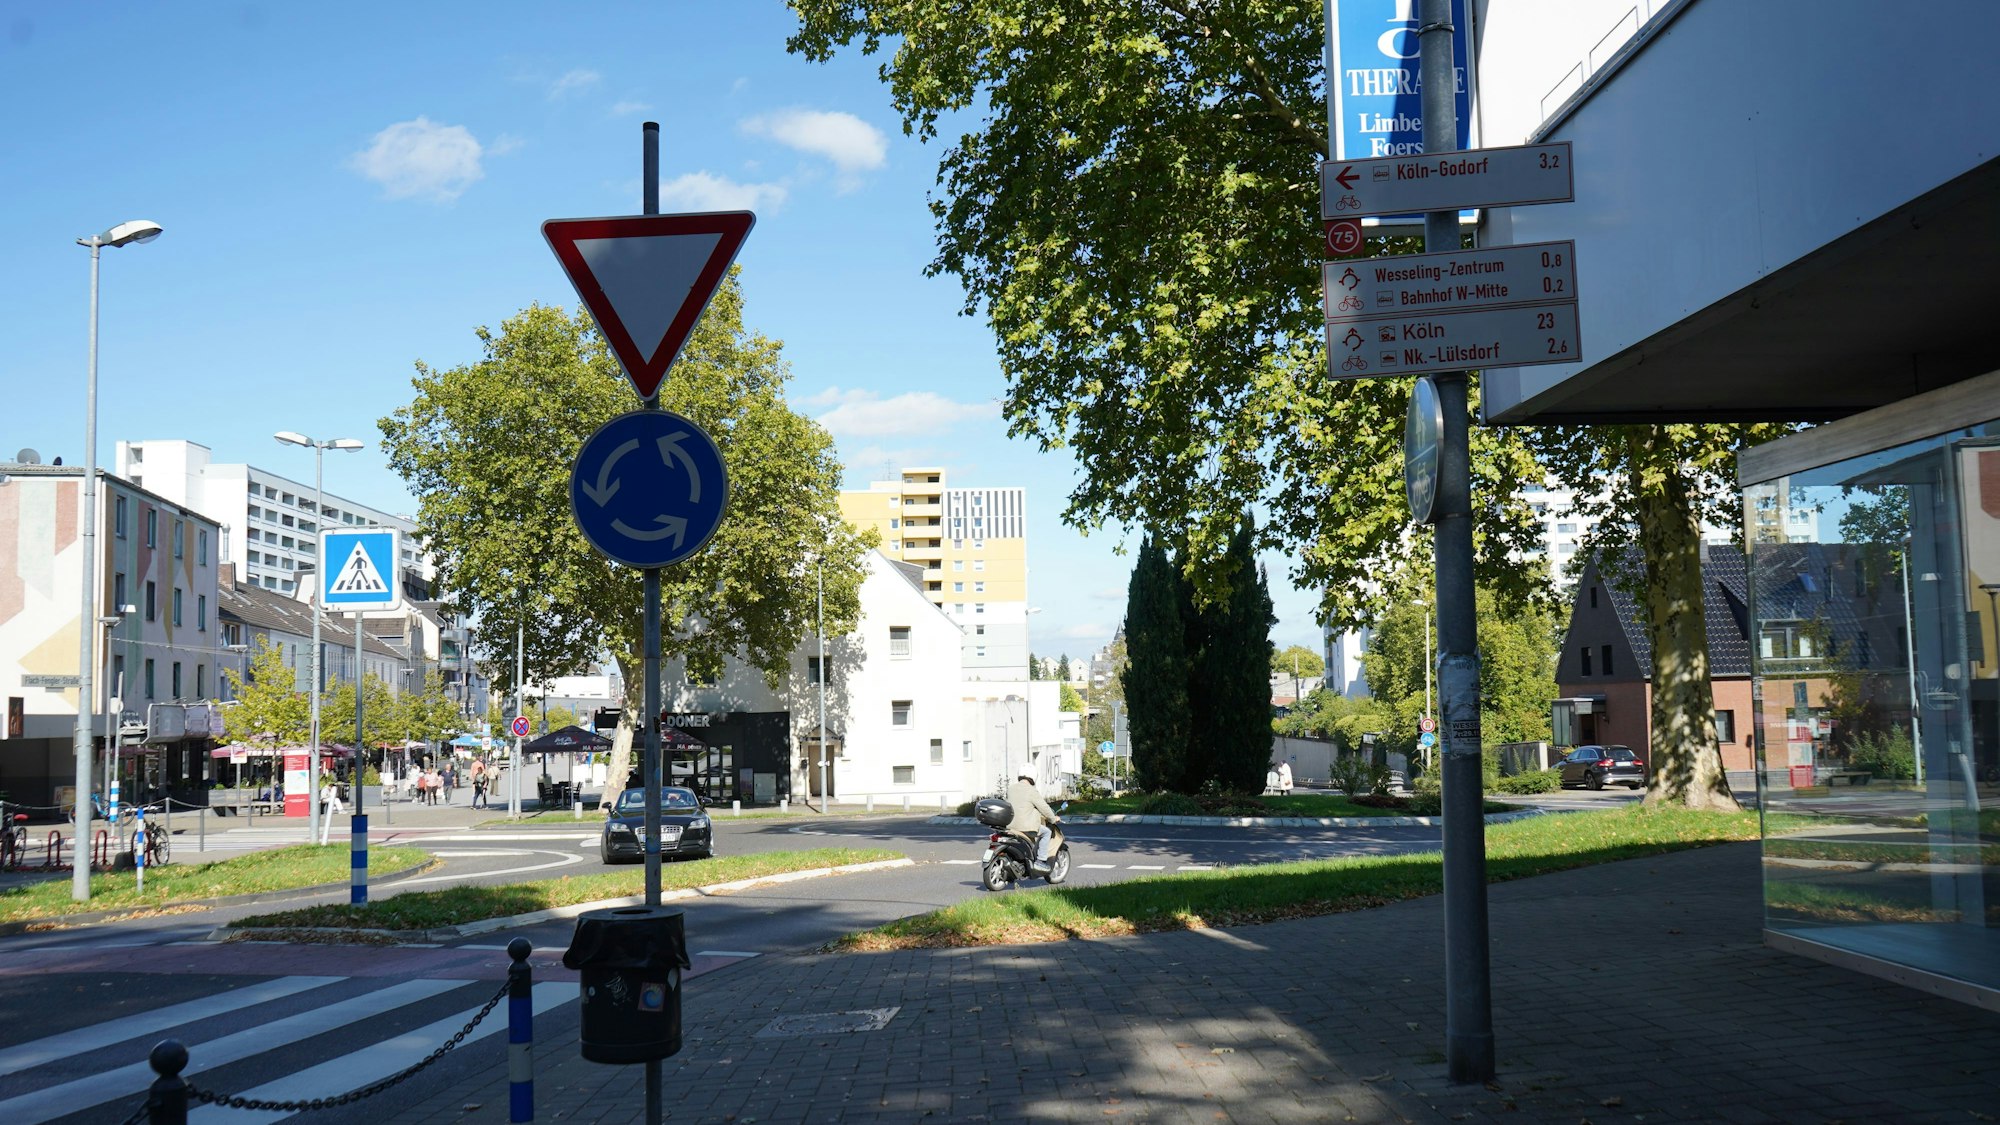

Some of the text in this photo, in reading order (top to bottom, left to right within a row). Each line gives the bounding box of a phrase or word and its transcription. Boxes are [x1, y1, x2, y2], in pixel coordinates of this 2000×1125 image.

[1397, 152, 1560, 181] Köln-Godorf 3,2
[1333, 230, 1354, 244] 75
[1375, 259, 1505, 283] Wesseling-Zentrum
[1401, 286, 1453, 305] Bahnhof
[1456, 282, 1508, 300] W-Mitte
[1403, 312, 1555, 341] Köln 23
[1404, 337, 1568, 365] Nk.-Lülsdorf 2,6
